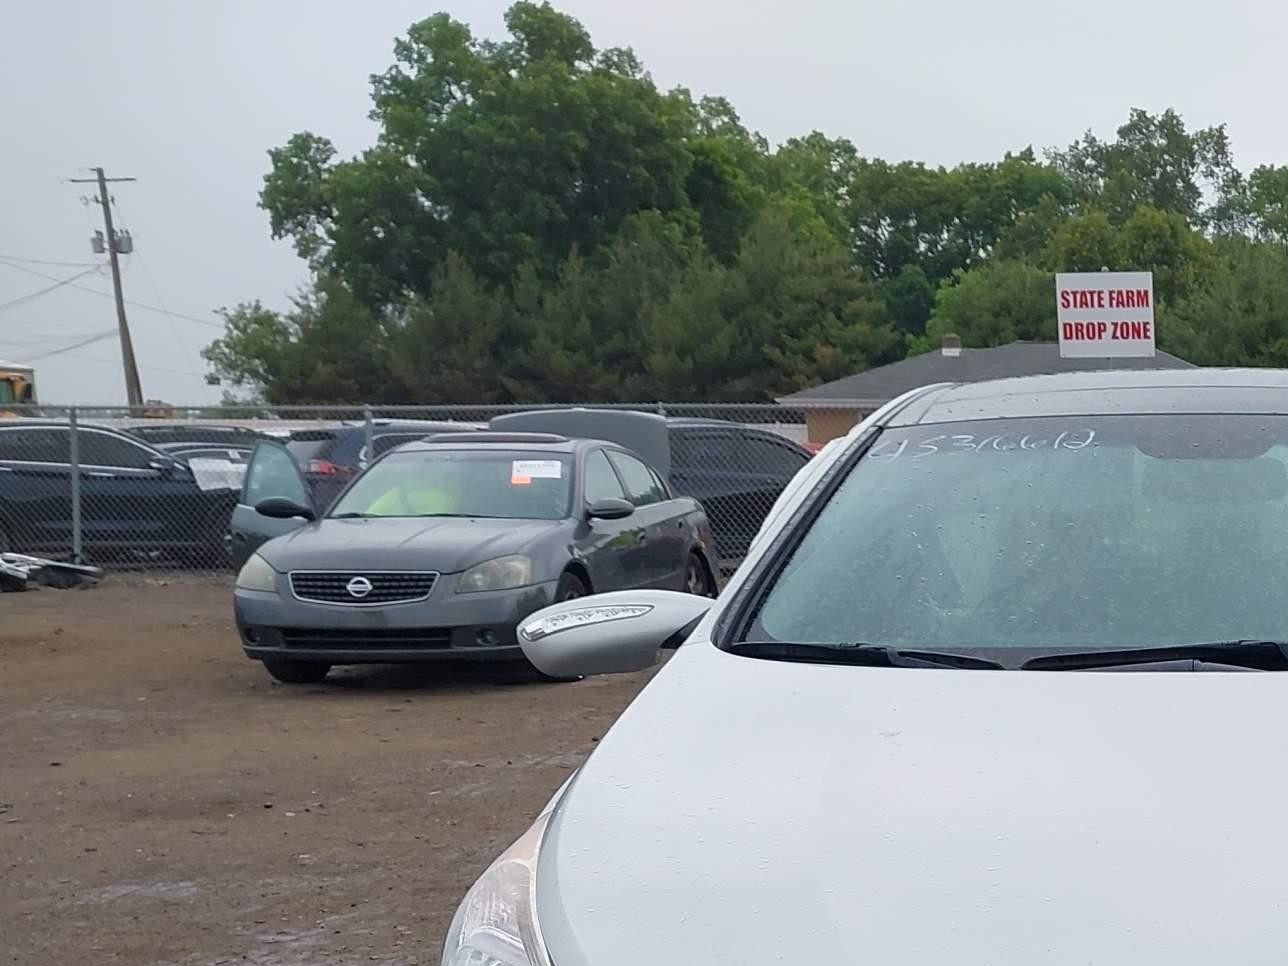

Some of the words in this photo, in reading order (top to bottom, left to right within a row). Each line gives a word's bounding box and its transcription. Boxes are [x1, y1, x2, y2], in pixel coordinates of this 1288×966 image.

[1061, 290, 1105, 309] STATE
[1108, 289, 1149, 308] FARM
[1063, 322, 1107, 340] DROP
[1111, 321, 1151, 340] ZONE
